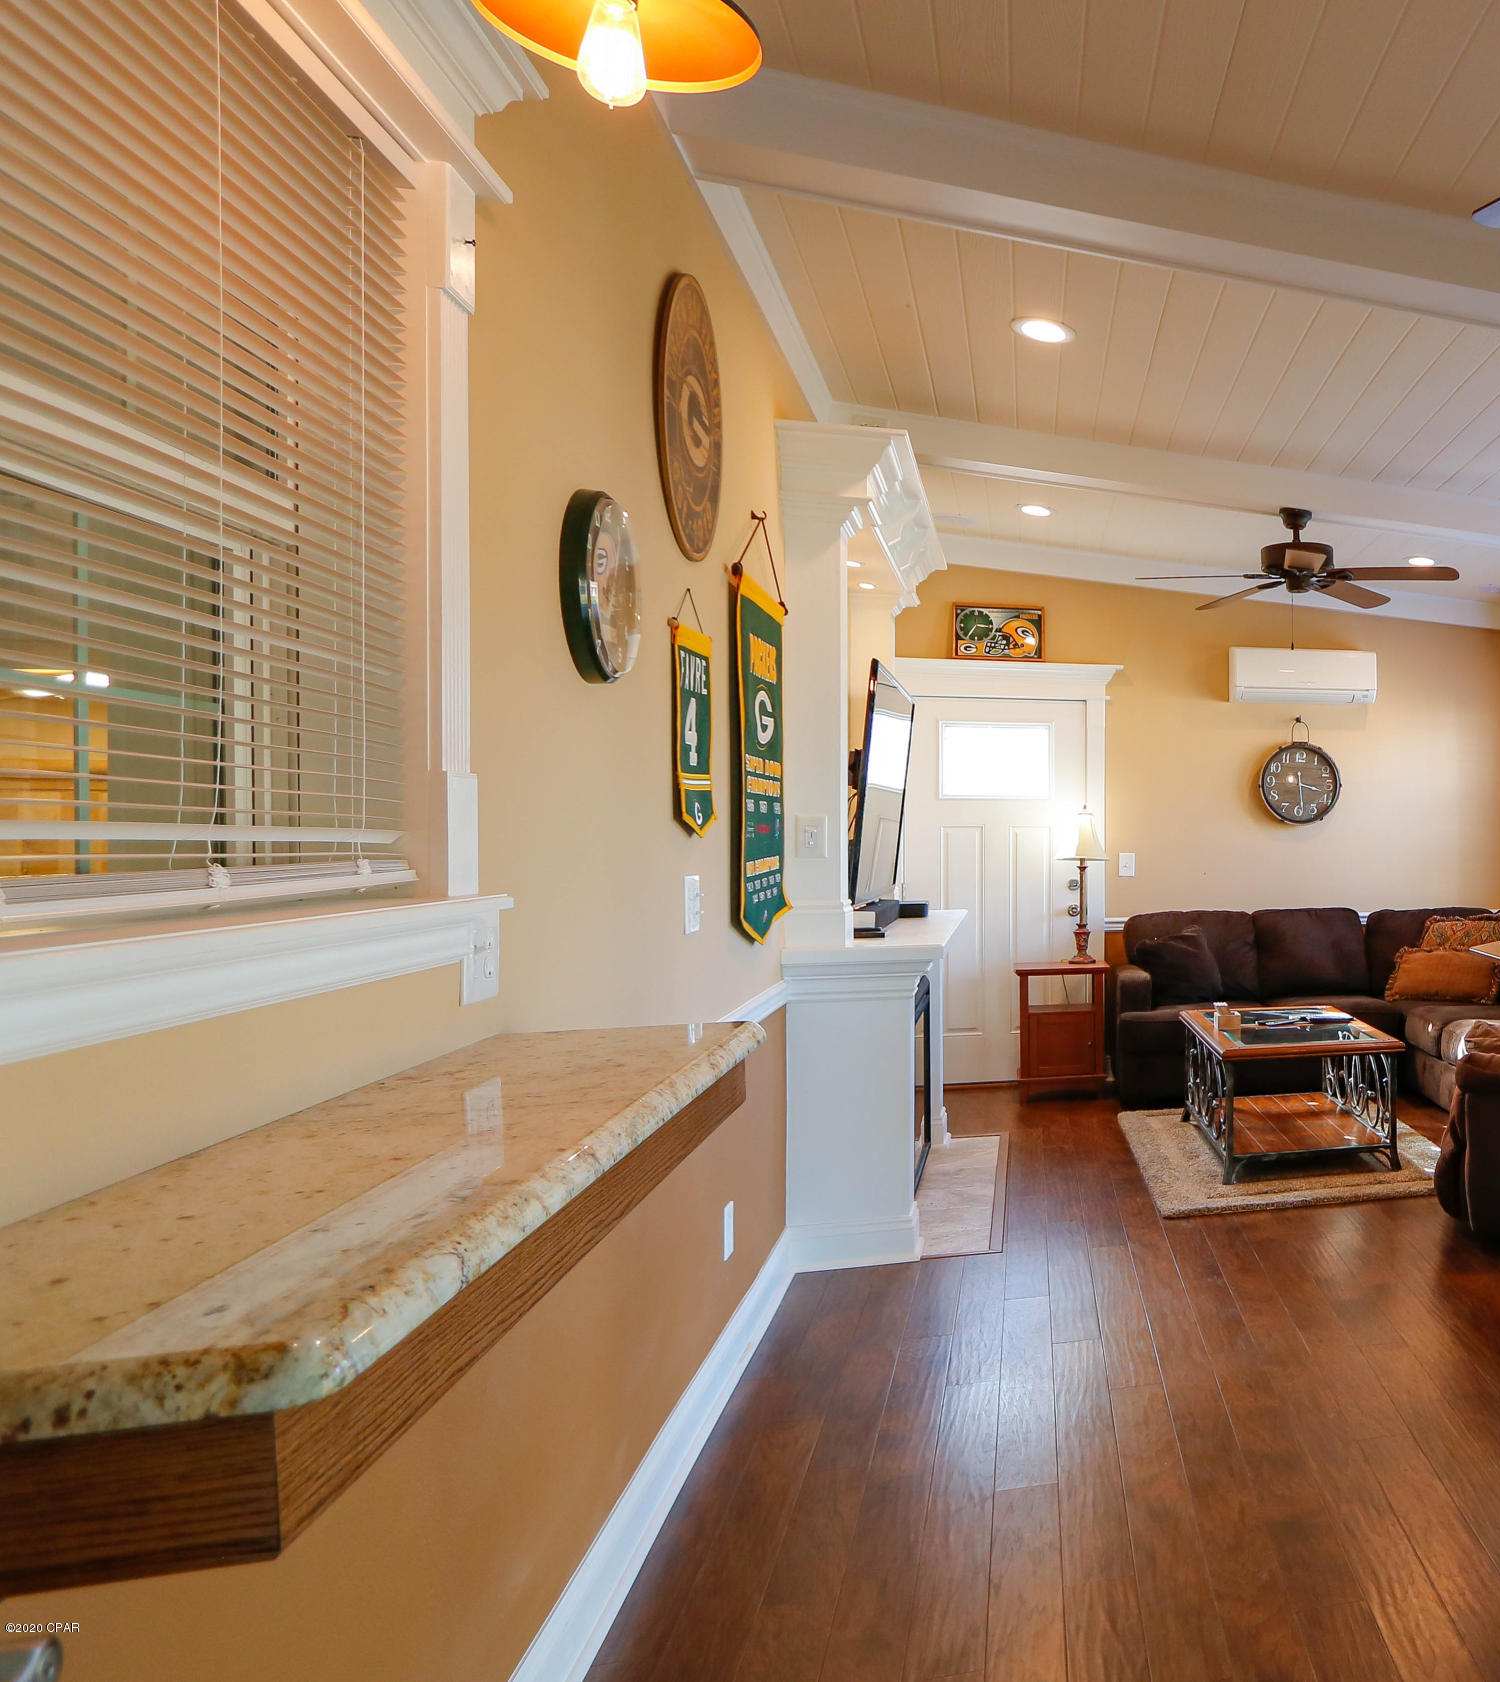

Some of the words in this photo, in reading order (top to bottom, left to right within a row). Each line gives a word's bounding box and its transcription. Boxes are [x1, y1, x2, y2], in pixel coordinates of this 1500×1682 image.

[679, 649, 708, 696] FAVRE
[754, 690, 775, 745] G
[684, 697, 698, 766] 4
[1282, 752, 1290, 764] 11
[1295, 751, 1307, 763] 12
[1270, 762, 1281, 773] 10
[1321, 765, 1330, 777] 2
[1266, 775, 1276, 787] 9
[1270, 790, 1279, 801] 8
[1319, 793, 1328, 804] 4
[1281, 802, 1290, 812] 7
[1294, 805, 1303, 816] 6
[694, 801, 703, 826] G
